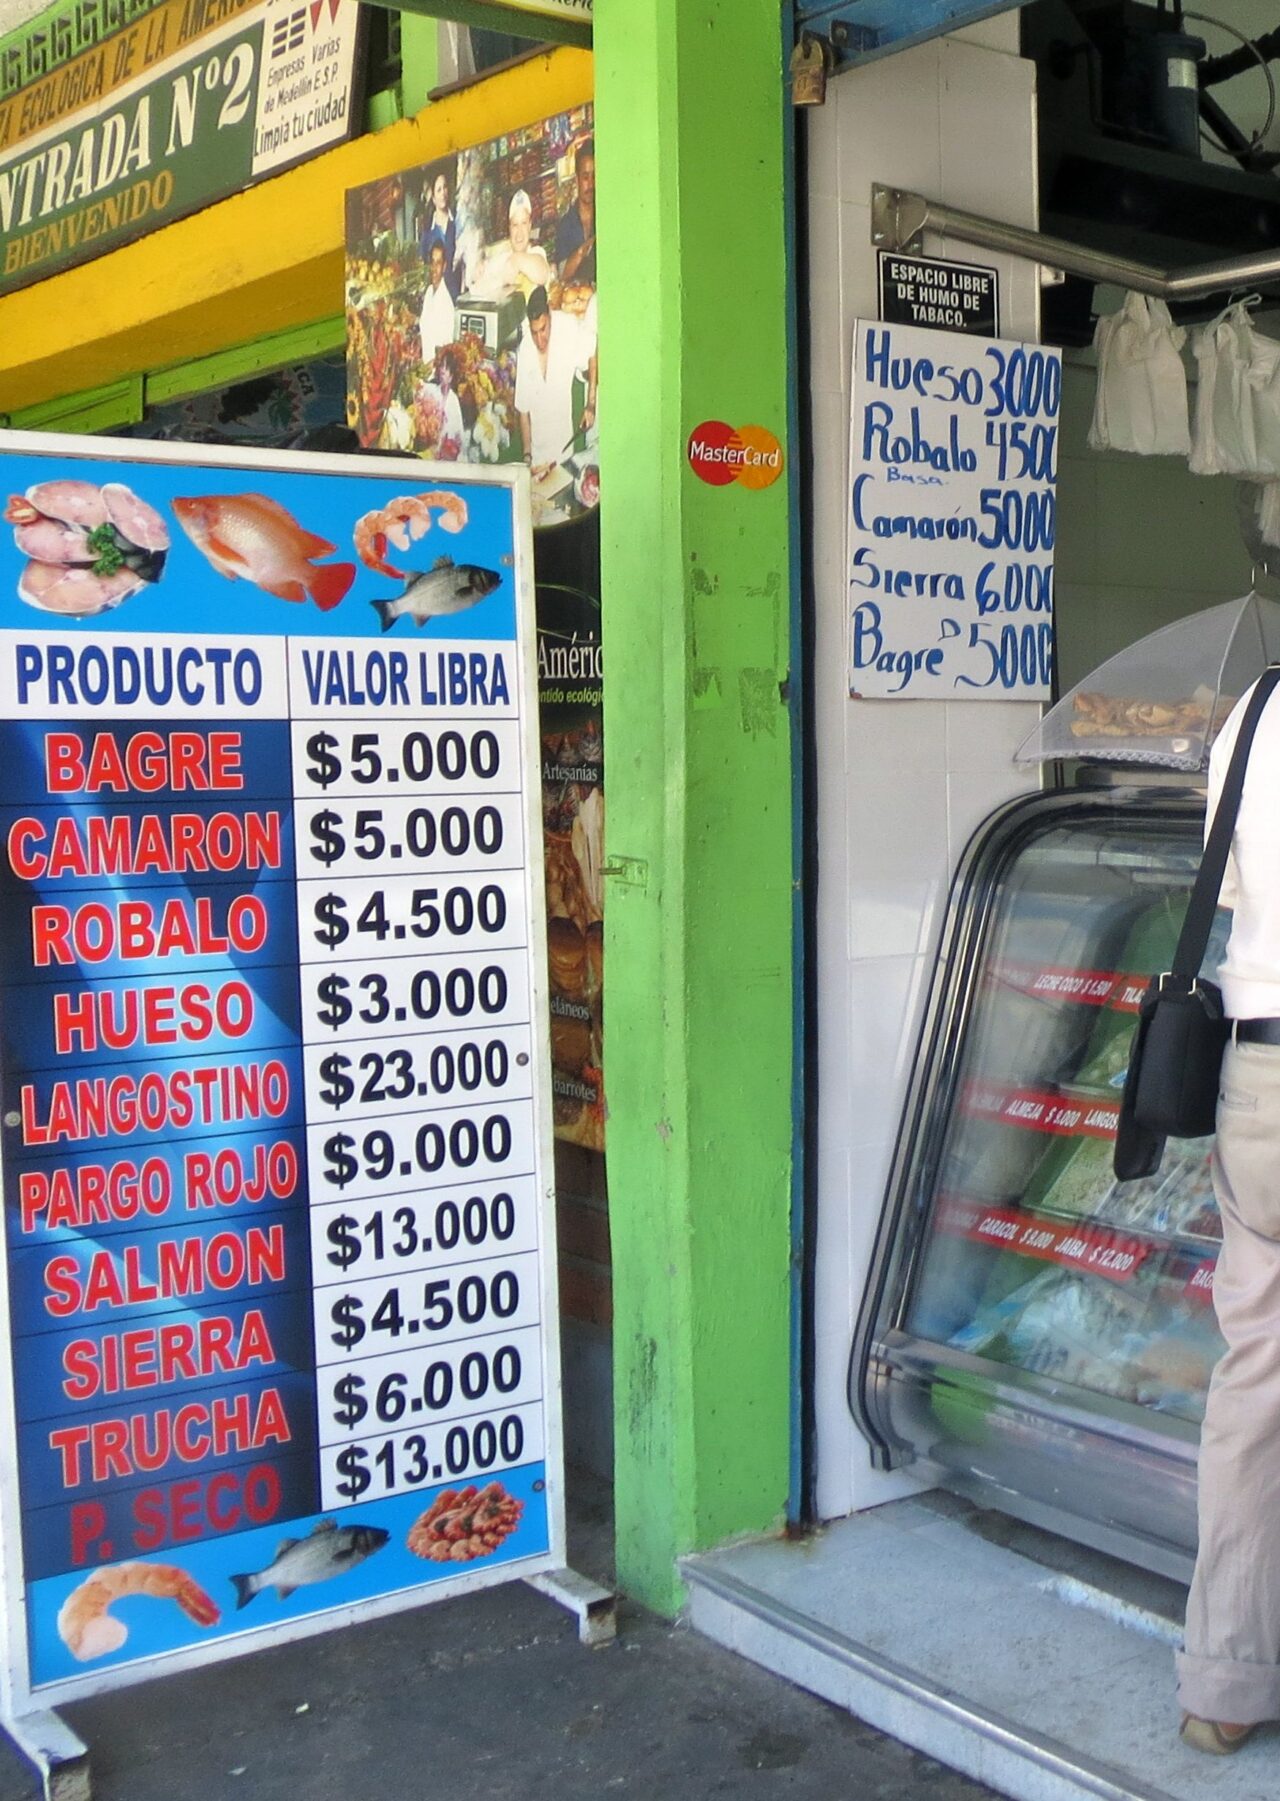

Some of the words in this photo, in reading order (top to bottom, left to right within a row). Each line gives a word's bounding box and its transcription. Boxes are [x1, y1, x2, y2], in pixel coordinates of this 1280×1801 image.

[112, 29, 138, 84] DE
[143, 10, 168, 66] LA
[267, 56, 306, 88] Empresas
[312, 37, 341, 64] Varias
[253, 116, 290, 157] Limpia
[307, 85, 348, 132] ciudad
[264, 94, 275, 114] de
[4, 170, 174, 273] BIENVENIDO
[891, 263, 948, 287] ESPACIO
[952, 273, 989, 294] LIBRE
[897, 283, 915, 300] DE
[919, 286, 959, 307] HUMO
[963, 295, 980, 311] DE
[911, 304, 967, 327] TABACO.
[865, 329, 983, 405] Hueso
[984, 347, 1062, 418] 3000
[690, 441, 780, 468] MasterCard
[863, 400, 978, 473] Robalo
[977, 488, 1057, 553] 5000
[851, 547, 965, 601] Sierra
[15, 644, 263, 707] PRODUCTO
[302, 649, 411, 707] VALOR
[419, 652, 510, 707] LIBRA
[852, 601, 944, 693] Bagre
[44, 732, 245, 794] BAGRE
[543, 762, 598, 782] Artesanías
[8, 811, 282, 880] CAMARON
[32, 895, 268, 967] ROBALO
[54, 980, 254, 1055] HUESO
[20, 1060, 290, 1146] LANGOSTINO
[1005, 1099, 1045, 1120] ALMEJA
[19, 1156, 171, 1234] PARGO
[184, 1140, 298, 1211] ROJO
[44, 1224, 286, 1318] SALMON
[1054, 1236, 1088, 1259] JAIBA
[1088, 1246, 1102, 1264] $
[1097, 1249, 1136, 1272] 12.000
[61, 1309, 277, 1400] SIERRA
[49, 1388, 293, 1489] TRUCHA
[70, 1502, 114, 1566] P.
[131, 1463, 283, 1552] SECO
